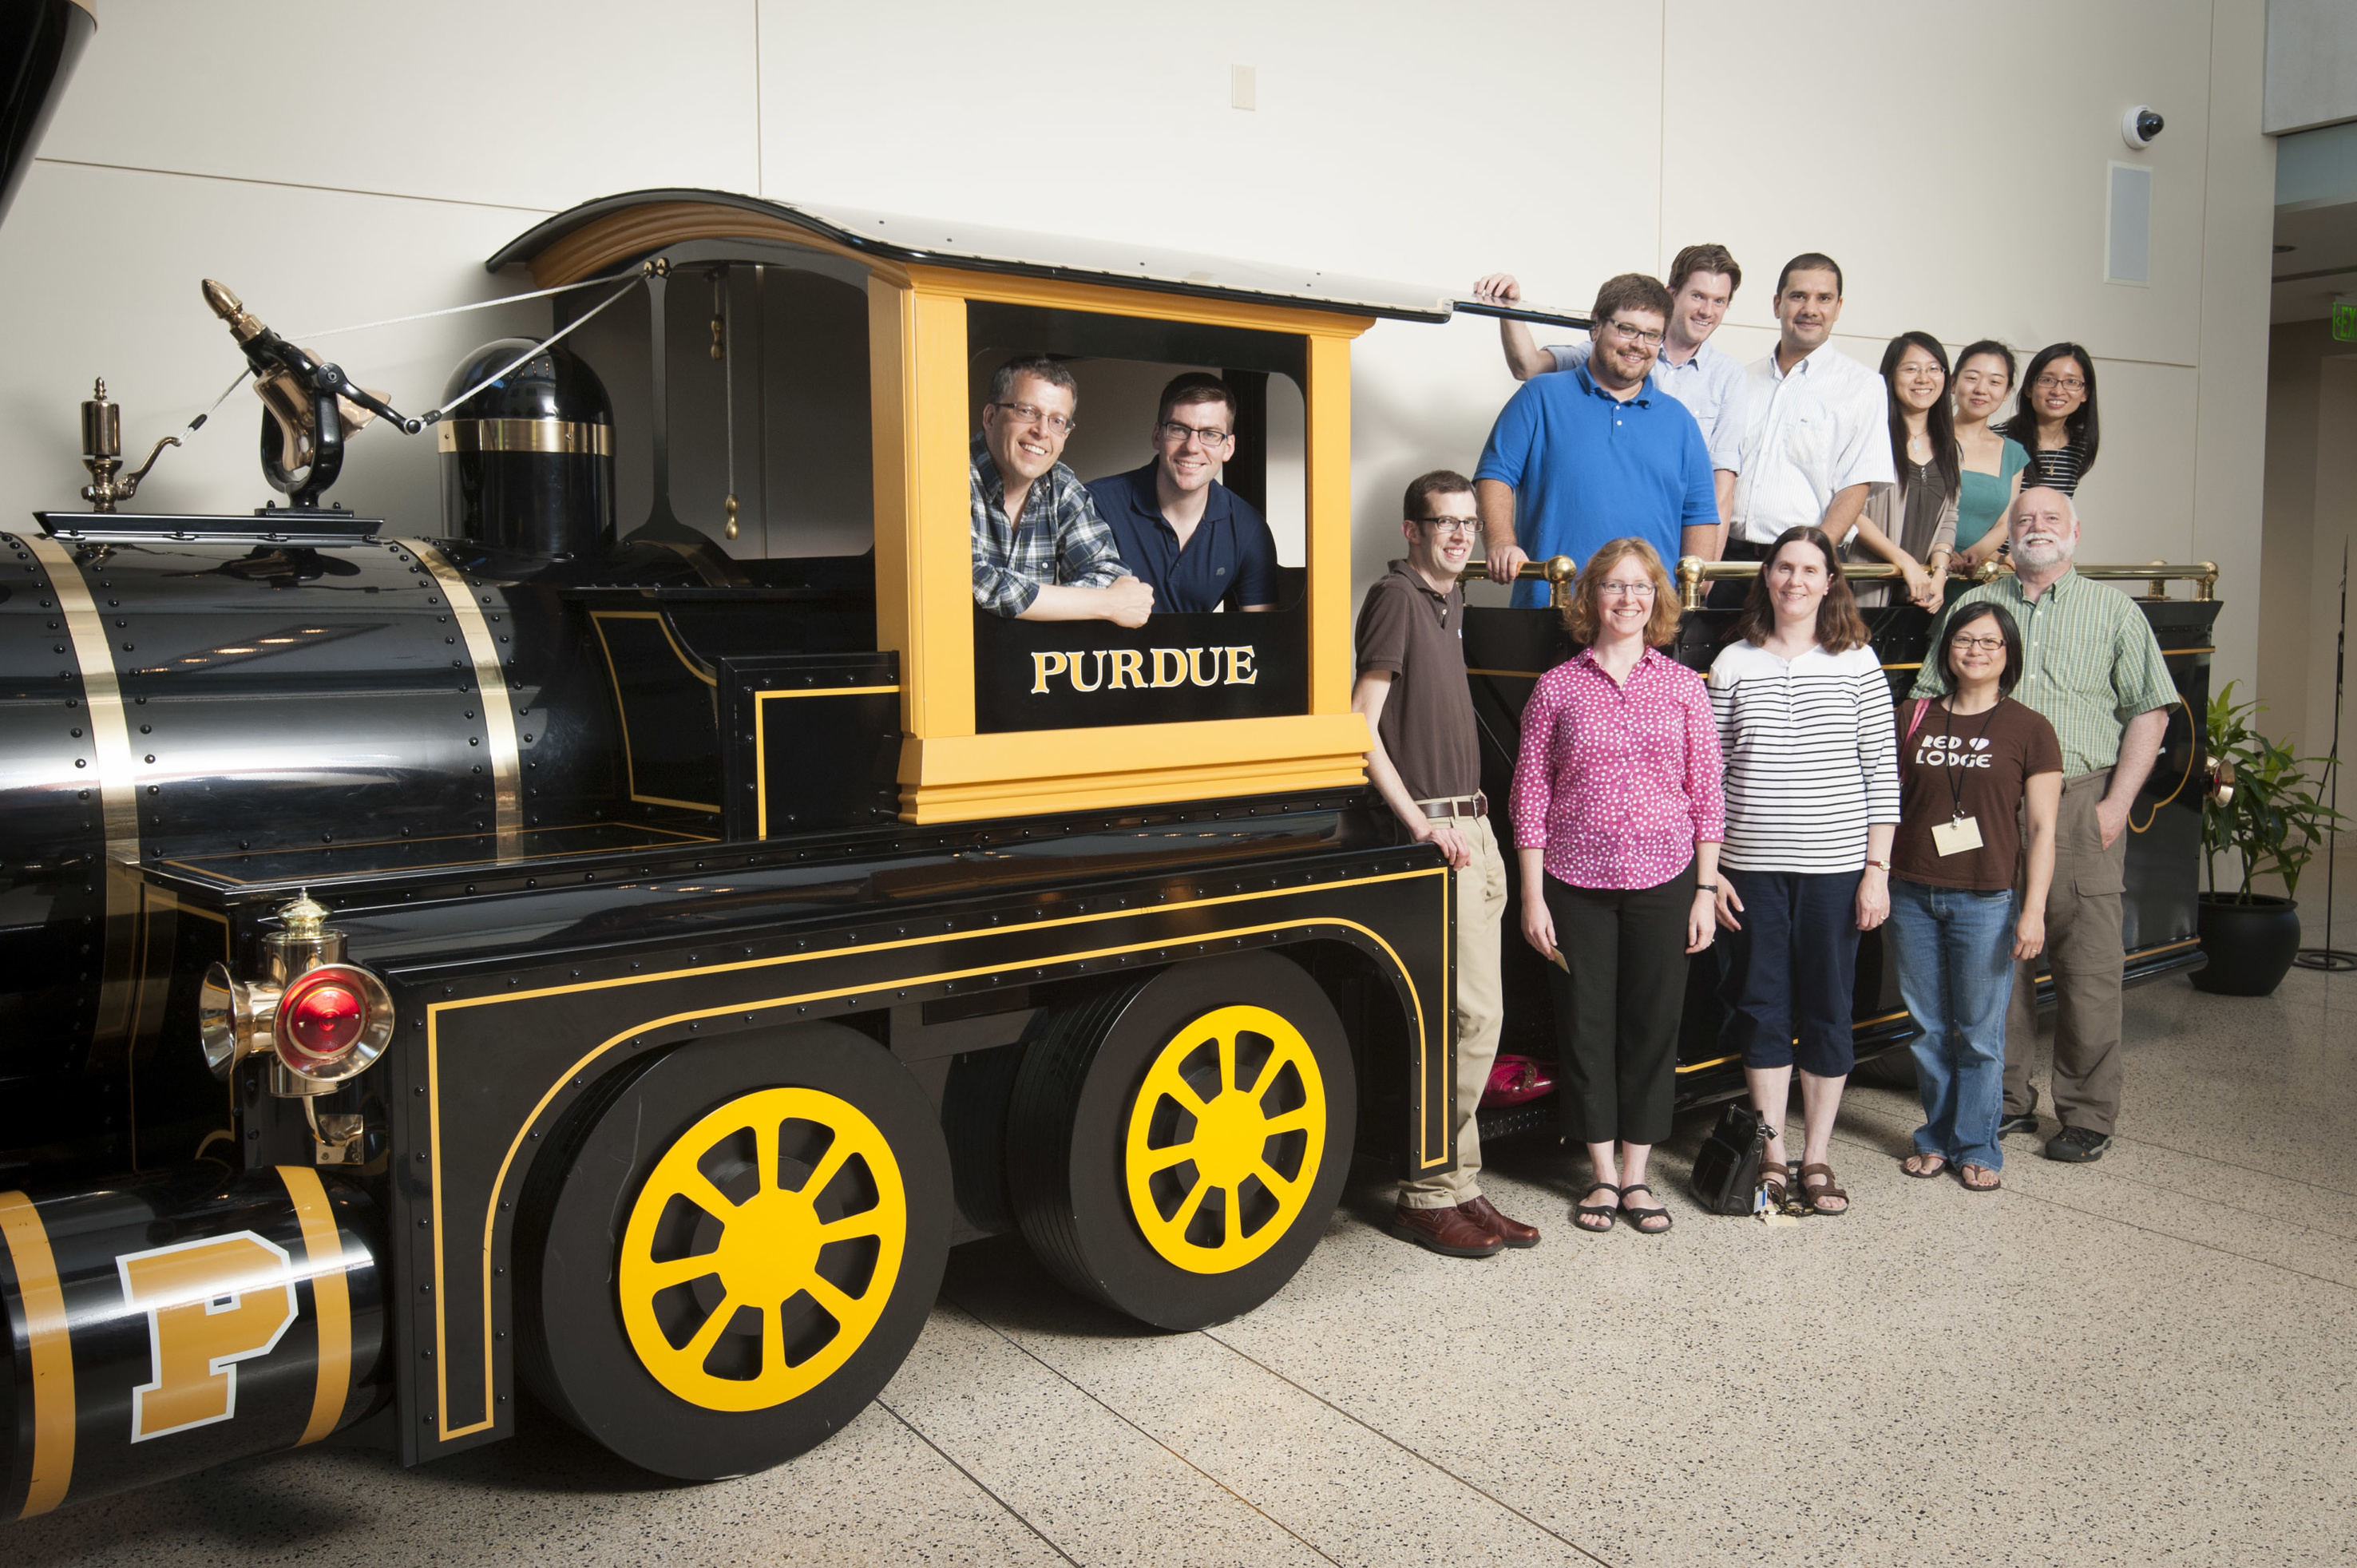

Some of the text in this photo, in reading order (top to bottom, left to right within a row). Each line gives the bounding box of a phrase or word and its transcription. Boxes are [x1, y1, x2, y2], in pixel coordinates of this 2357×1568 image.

[1031, 645, 1258, 695] PURDUE
[1915, 749, 1993, 768] LODGE
[1921, 735, 1963, 750] RED
[115, 1229, 299, 1444] P
